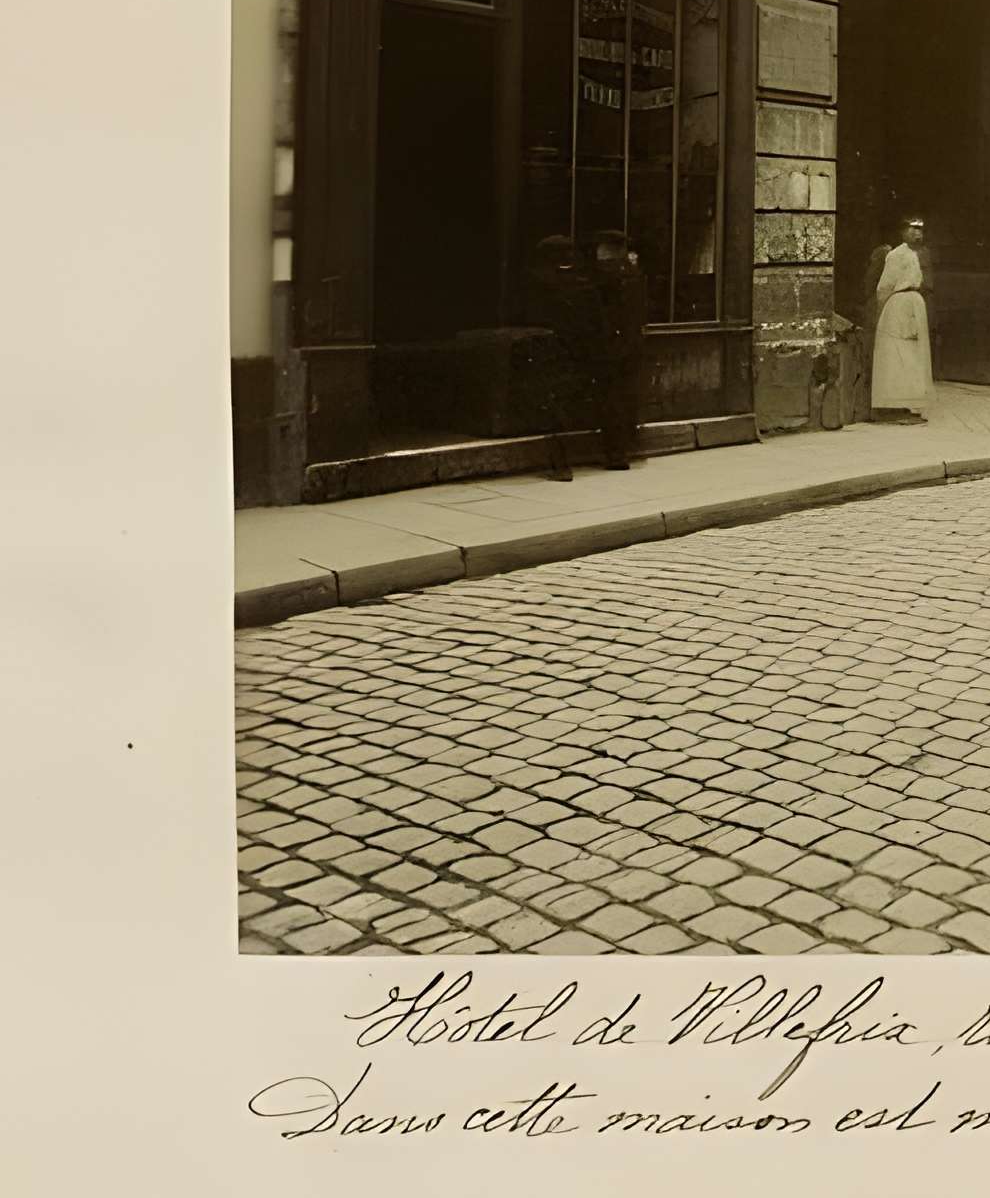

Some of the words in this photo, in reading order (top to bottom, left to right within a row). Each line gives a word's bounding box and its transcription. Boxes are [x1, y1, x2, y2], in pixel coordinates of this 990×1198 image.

[344, 970, 578, 1047] Hôtel
[572, 993, 646, 1045] de
[248, 1062, 447, 1140] Dans
[462, 1082, 598, 1137] cette
[597, 1094, 812, 1135] maison
[834, 1081, 940, 1132] est
